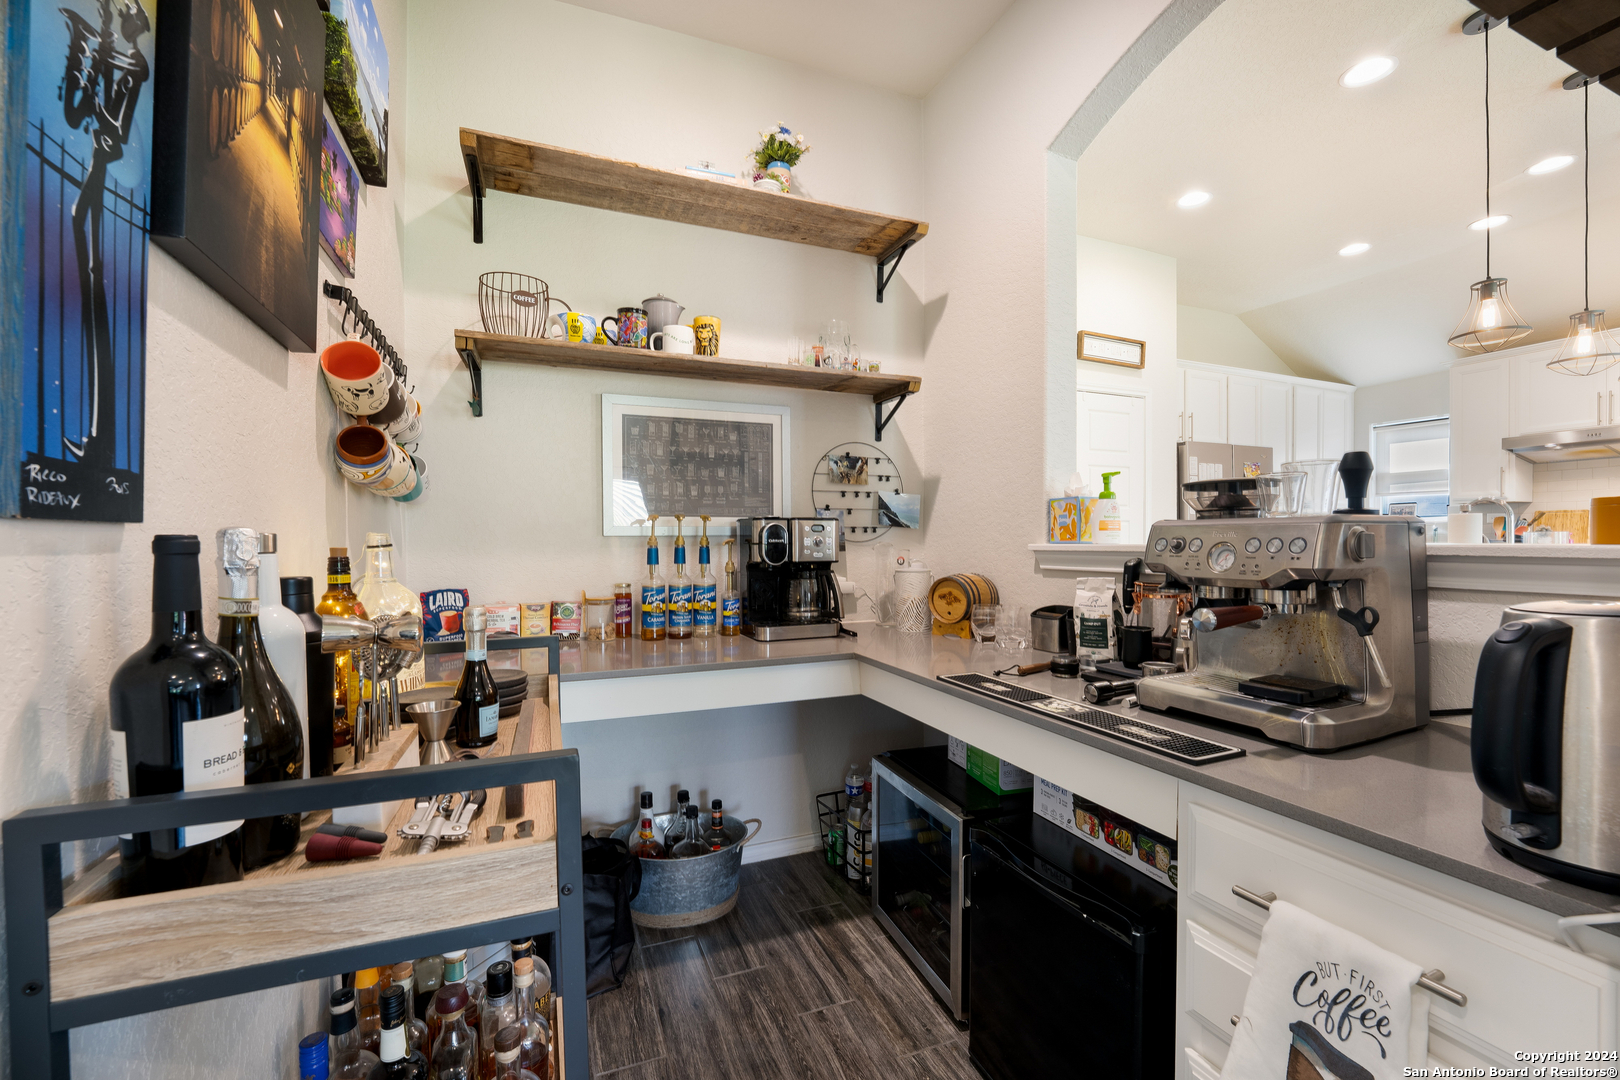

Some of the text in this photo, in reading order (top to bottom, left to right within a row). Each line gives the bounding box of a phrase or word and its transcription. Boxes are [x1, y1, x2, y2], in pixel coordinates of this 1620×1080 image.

[513, 294, 536, 304] COFFEE
[25, 463, 67, 482] RICCO
[1212, 530, 1238, 538] Breville
[428, 591, 464, 611] LAIRD
[203, 750, 237, 769] BREAD
[1316, 961, 1391, 1010] BUT FIRST
[1292, 970, 1391, 1042] Coffee
